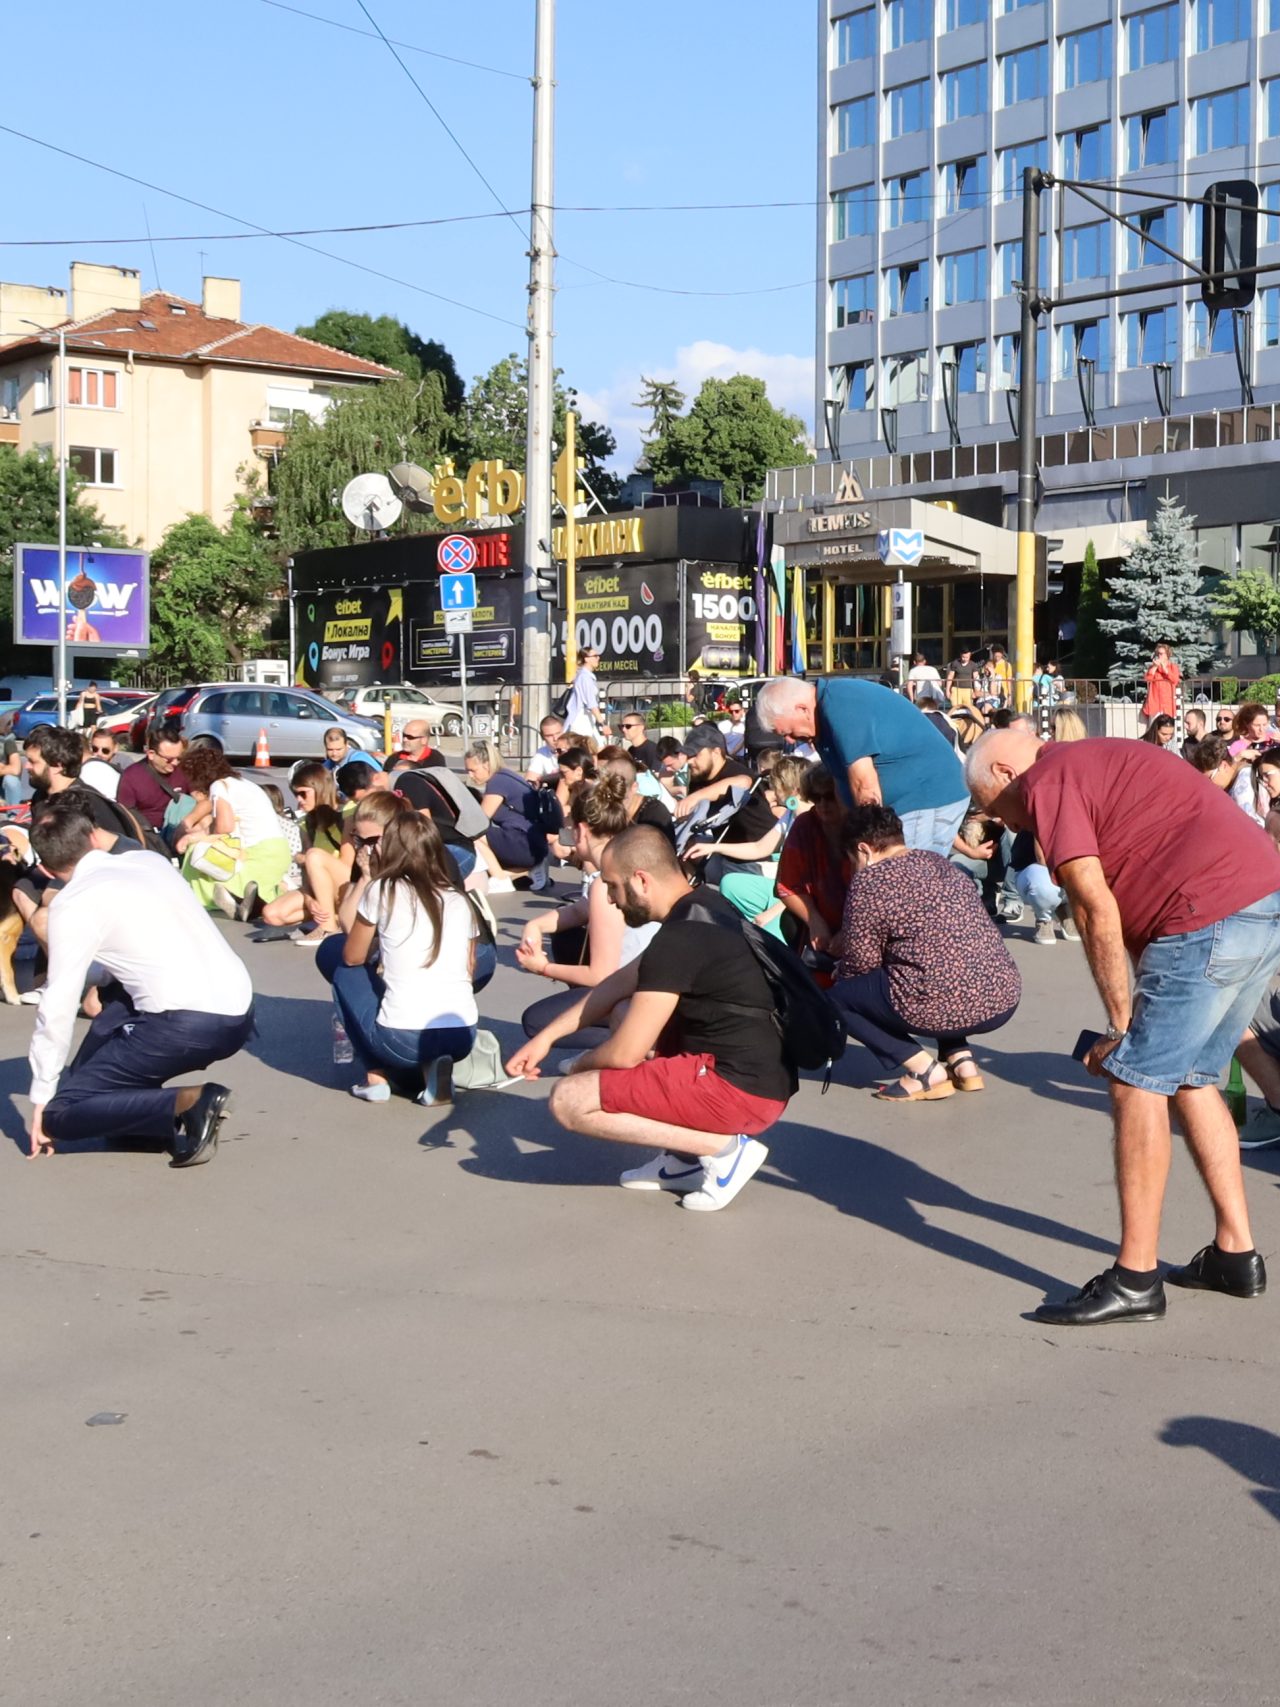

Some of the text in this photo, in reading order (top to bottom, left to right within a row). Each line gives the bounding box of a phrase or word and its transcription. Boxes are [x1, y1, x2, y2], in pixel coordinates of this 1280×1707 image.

[431, 448, 585, 524] efbt
[823, 544, 863, 555] HOTEL
[584, 575, 619, 594] efbet
[701, 571, 752, 590] efbet
[335, 600, 362, 615] efbet
[331, 623, 369, 638] Локална
[321, 644, 370, 662] Бонус Игра
[596, 660, 638, 672] СЕКИ МЕСЕЦ
